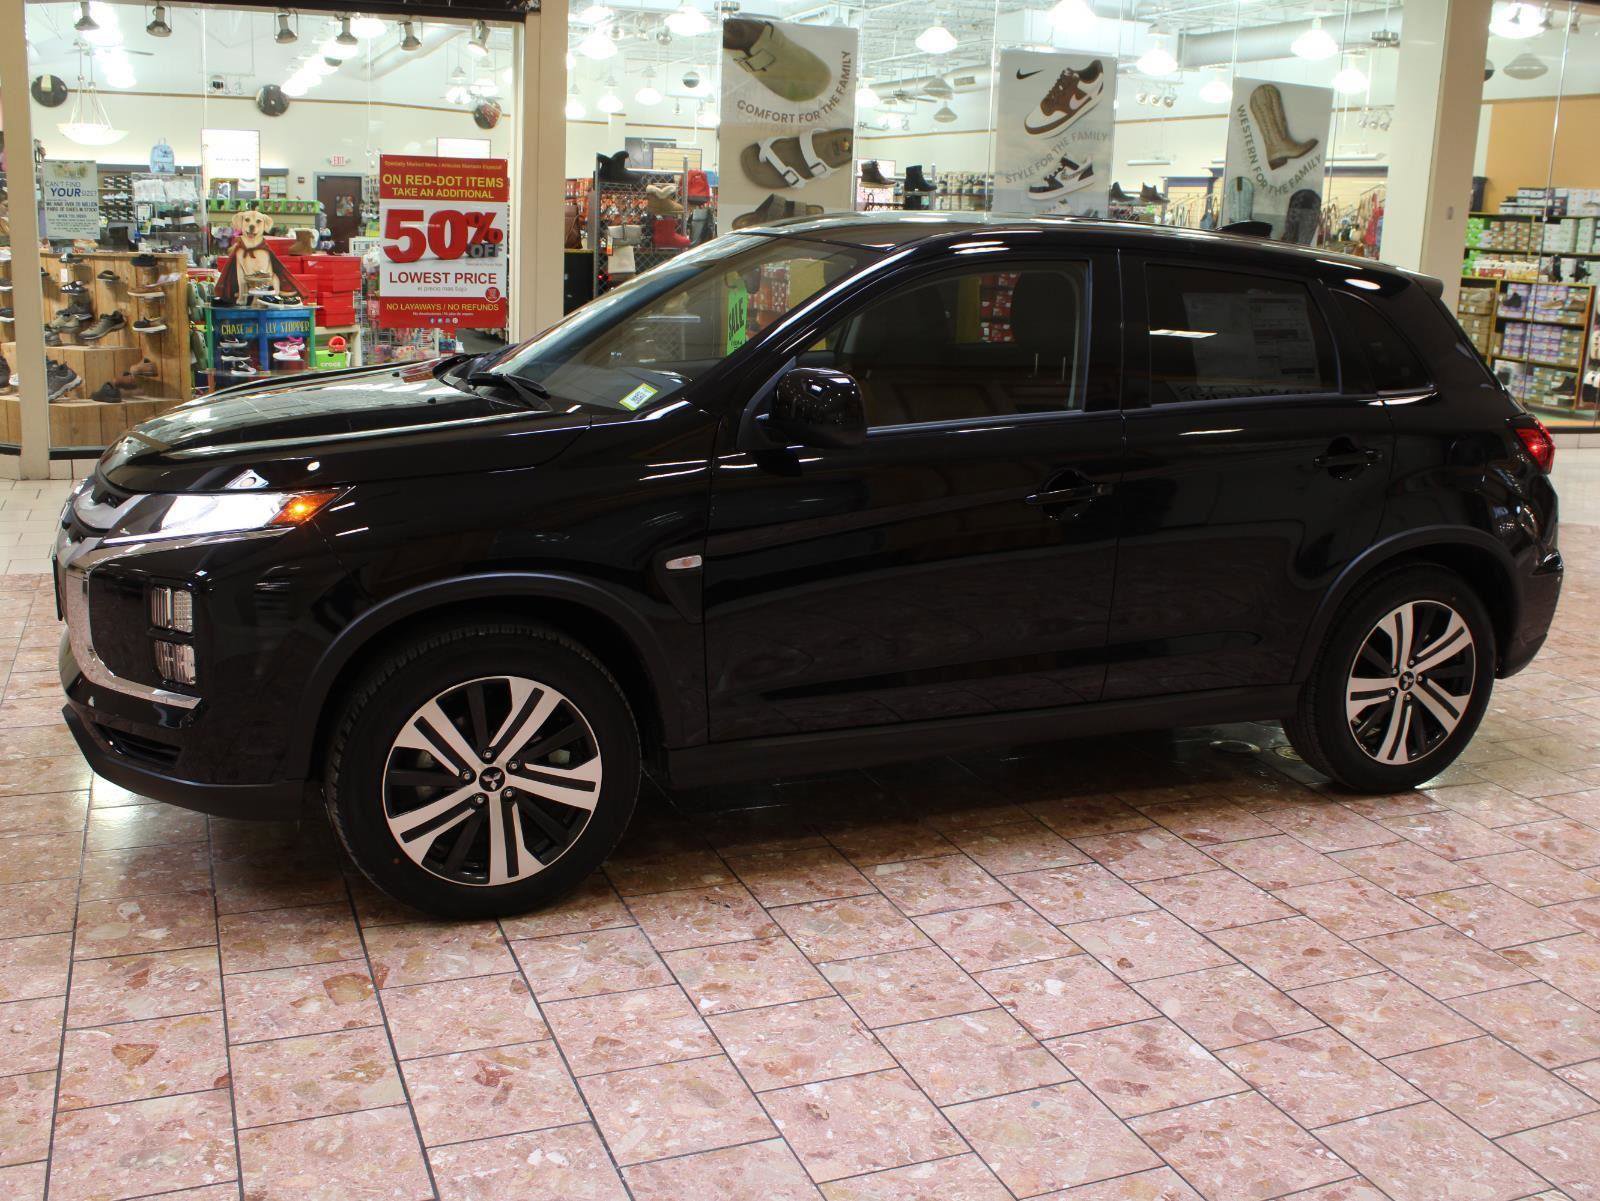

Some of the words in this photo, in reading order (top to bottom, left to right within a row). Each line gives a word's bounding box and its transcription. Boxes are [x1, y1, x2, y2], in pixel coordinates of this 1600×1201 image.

[737, 100, 795, 124] COMFORT
[799, 110, 821, 124] FOR
[820, 96, 841, 115] THE
[835, 51, 852, 96] FAMILY
[1006, 167, 1036, 184] STYLE
[1035, 153, 1055, 171] FOR
[1053, 138, 1070, 155] THE
[1072, 129, 1108, 142] FAMILY
[1236, 104, 1259, 165] WESTERN
[1253, 166, 1269, 189] FOR
[1268, 184, 1289, 197] THE
[1289, 154, 1322, 189] FAMILY
[333, 155, 345, 165] EXIT
[382, 173, 402, 185] ON
[405, 174, 463, 187] RED-DOT
[466, 177, 504, 188] ITEMS
[51, 188, 81, 197] YOUR
[392, 187, 418, 197] TAKE
[420, 188, 434, 197] AN
[436, 188, 495, 199] ADDITIONAL
[383, 209, 503, 263] 50%
[466, 243, 503, 258] OFF
[389, 272, 450, 284] LOWEST
[454, 272, 497, 285] PRICE
[400, 303, 442, 311] LAYAWAYS
[447, 303, 460, 311] NO
[729, 297, 745, 341] SALE
